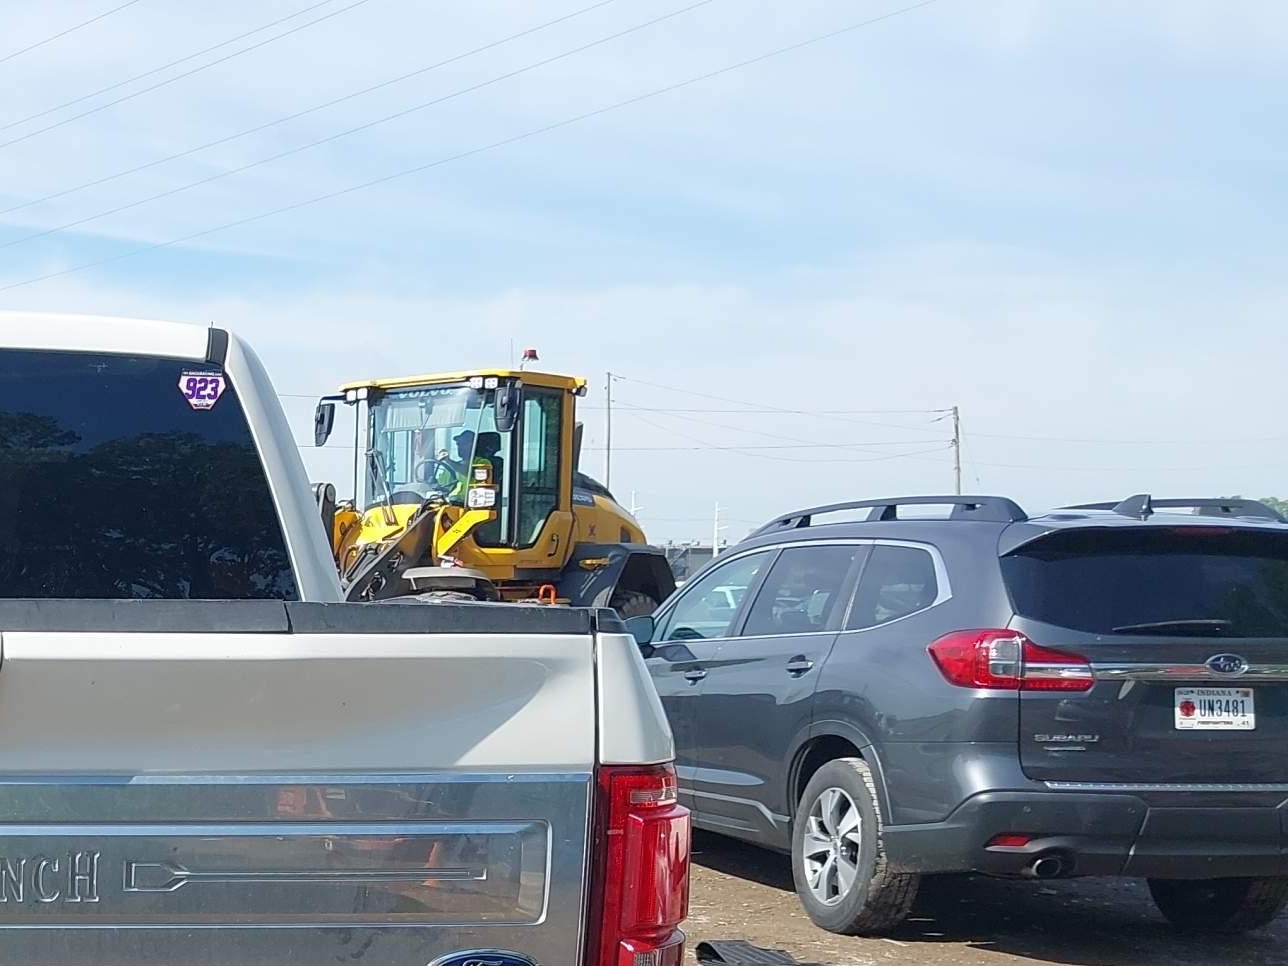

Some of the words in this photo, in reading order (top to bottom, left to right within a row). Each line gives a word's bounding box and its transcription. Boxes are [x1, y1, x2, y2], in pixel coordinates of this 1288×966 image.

[184, 377, 220, 400] 923
[1197, 689, 1232, 697] INDIANA
[1199, 699, 1247, 717] UN3481
